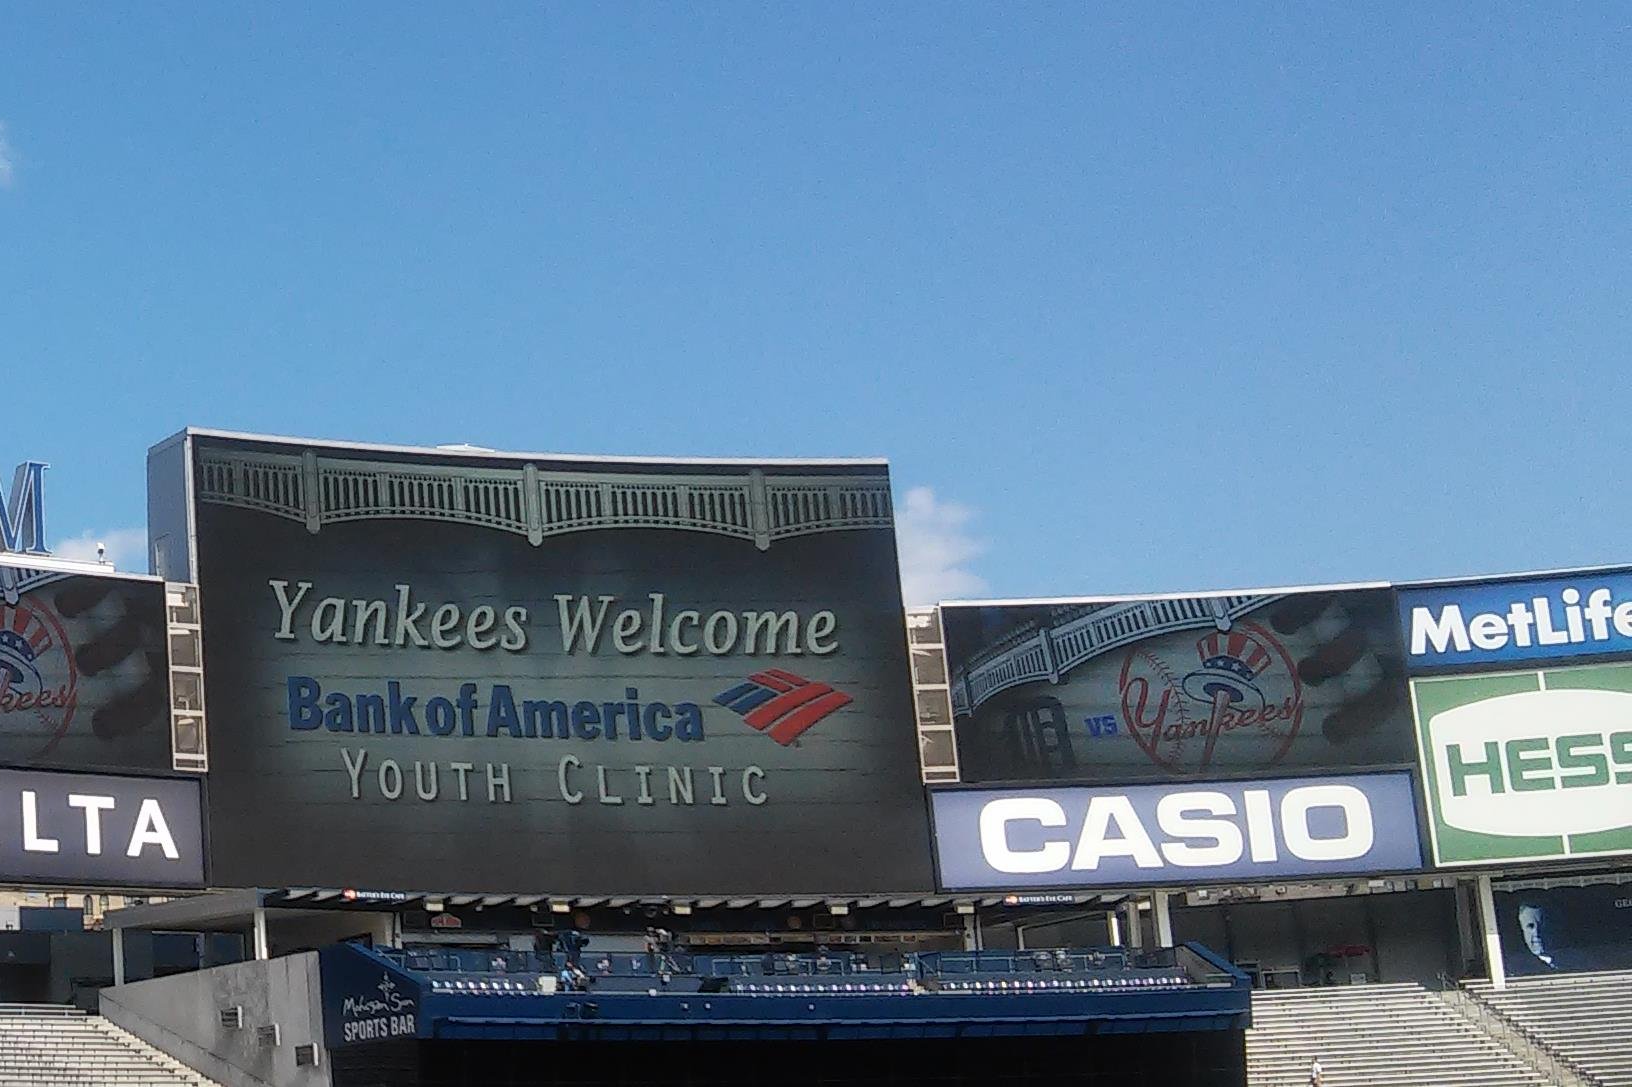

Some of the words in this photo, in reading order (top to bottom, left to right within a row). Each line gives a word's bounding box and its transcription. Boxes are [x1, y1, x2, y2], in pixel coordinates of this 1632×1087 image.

[269, 578, 529, 654] Yankees
[554, 591, 840, 657] Welcome
[287, 675, 420, 735] Bank
[426, 683, 479, 738] of
[486, 684, 706, 742] America
[979, 785, 1374, 873] CASIO
[344, 1017, 388, 1041] SPORTS
[390, 1014, 415, 1036] BAR
